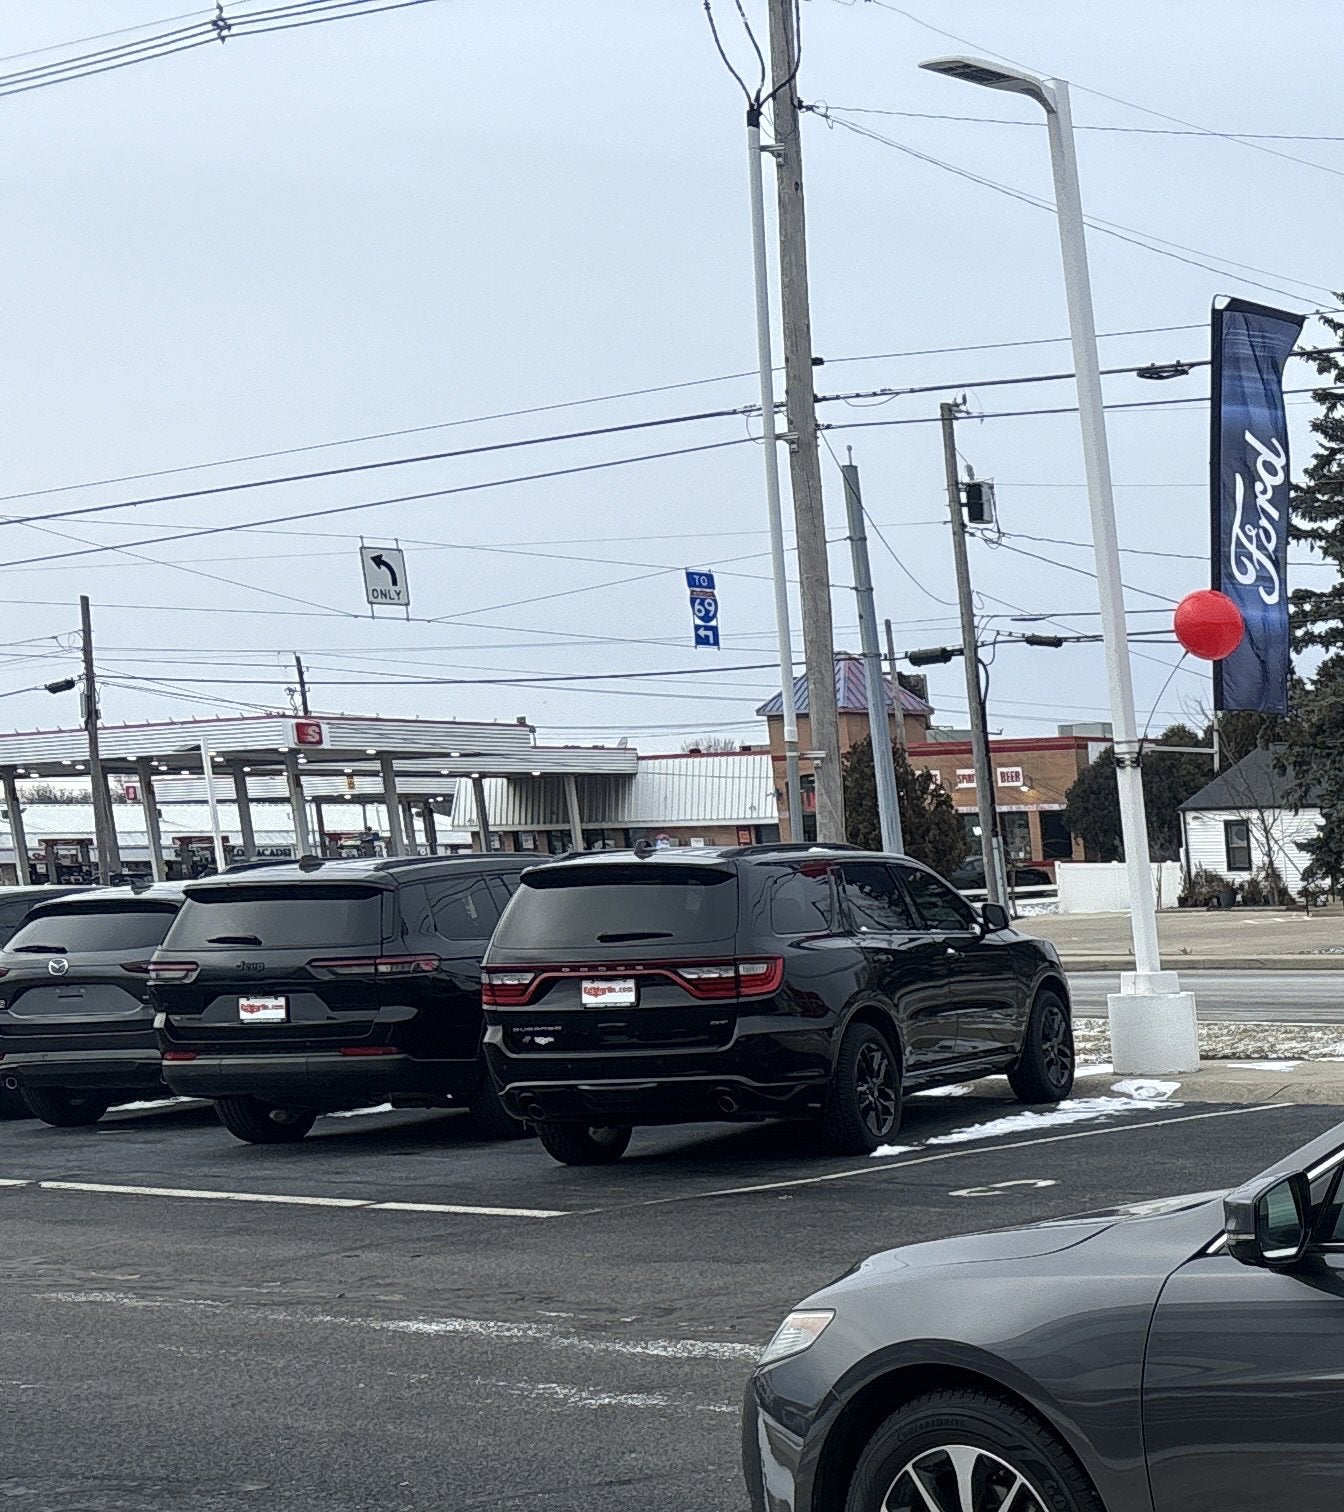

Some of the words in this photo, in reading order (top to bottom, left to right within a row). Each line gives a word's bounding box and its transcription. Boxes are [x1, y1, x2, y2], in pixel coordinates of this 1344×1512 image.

[1231, 430, 1286, 605] Ford
[693, 575, 708, 586] TO
[371, 588, 402, 600] ONLY
[694, 598, 715, 617] 69
[1000, 770, 1021, 784] BEER
[235, 960, 266, 973] Jeep
